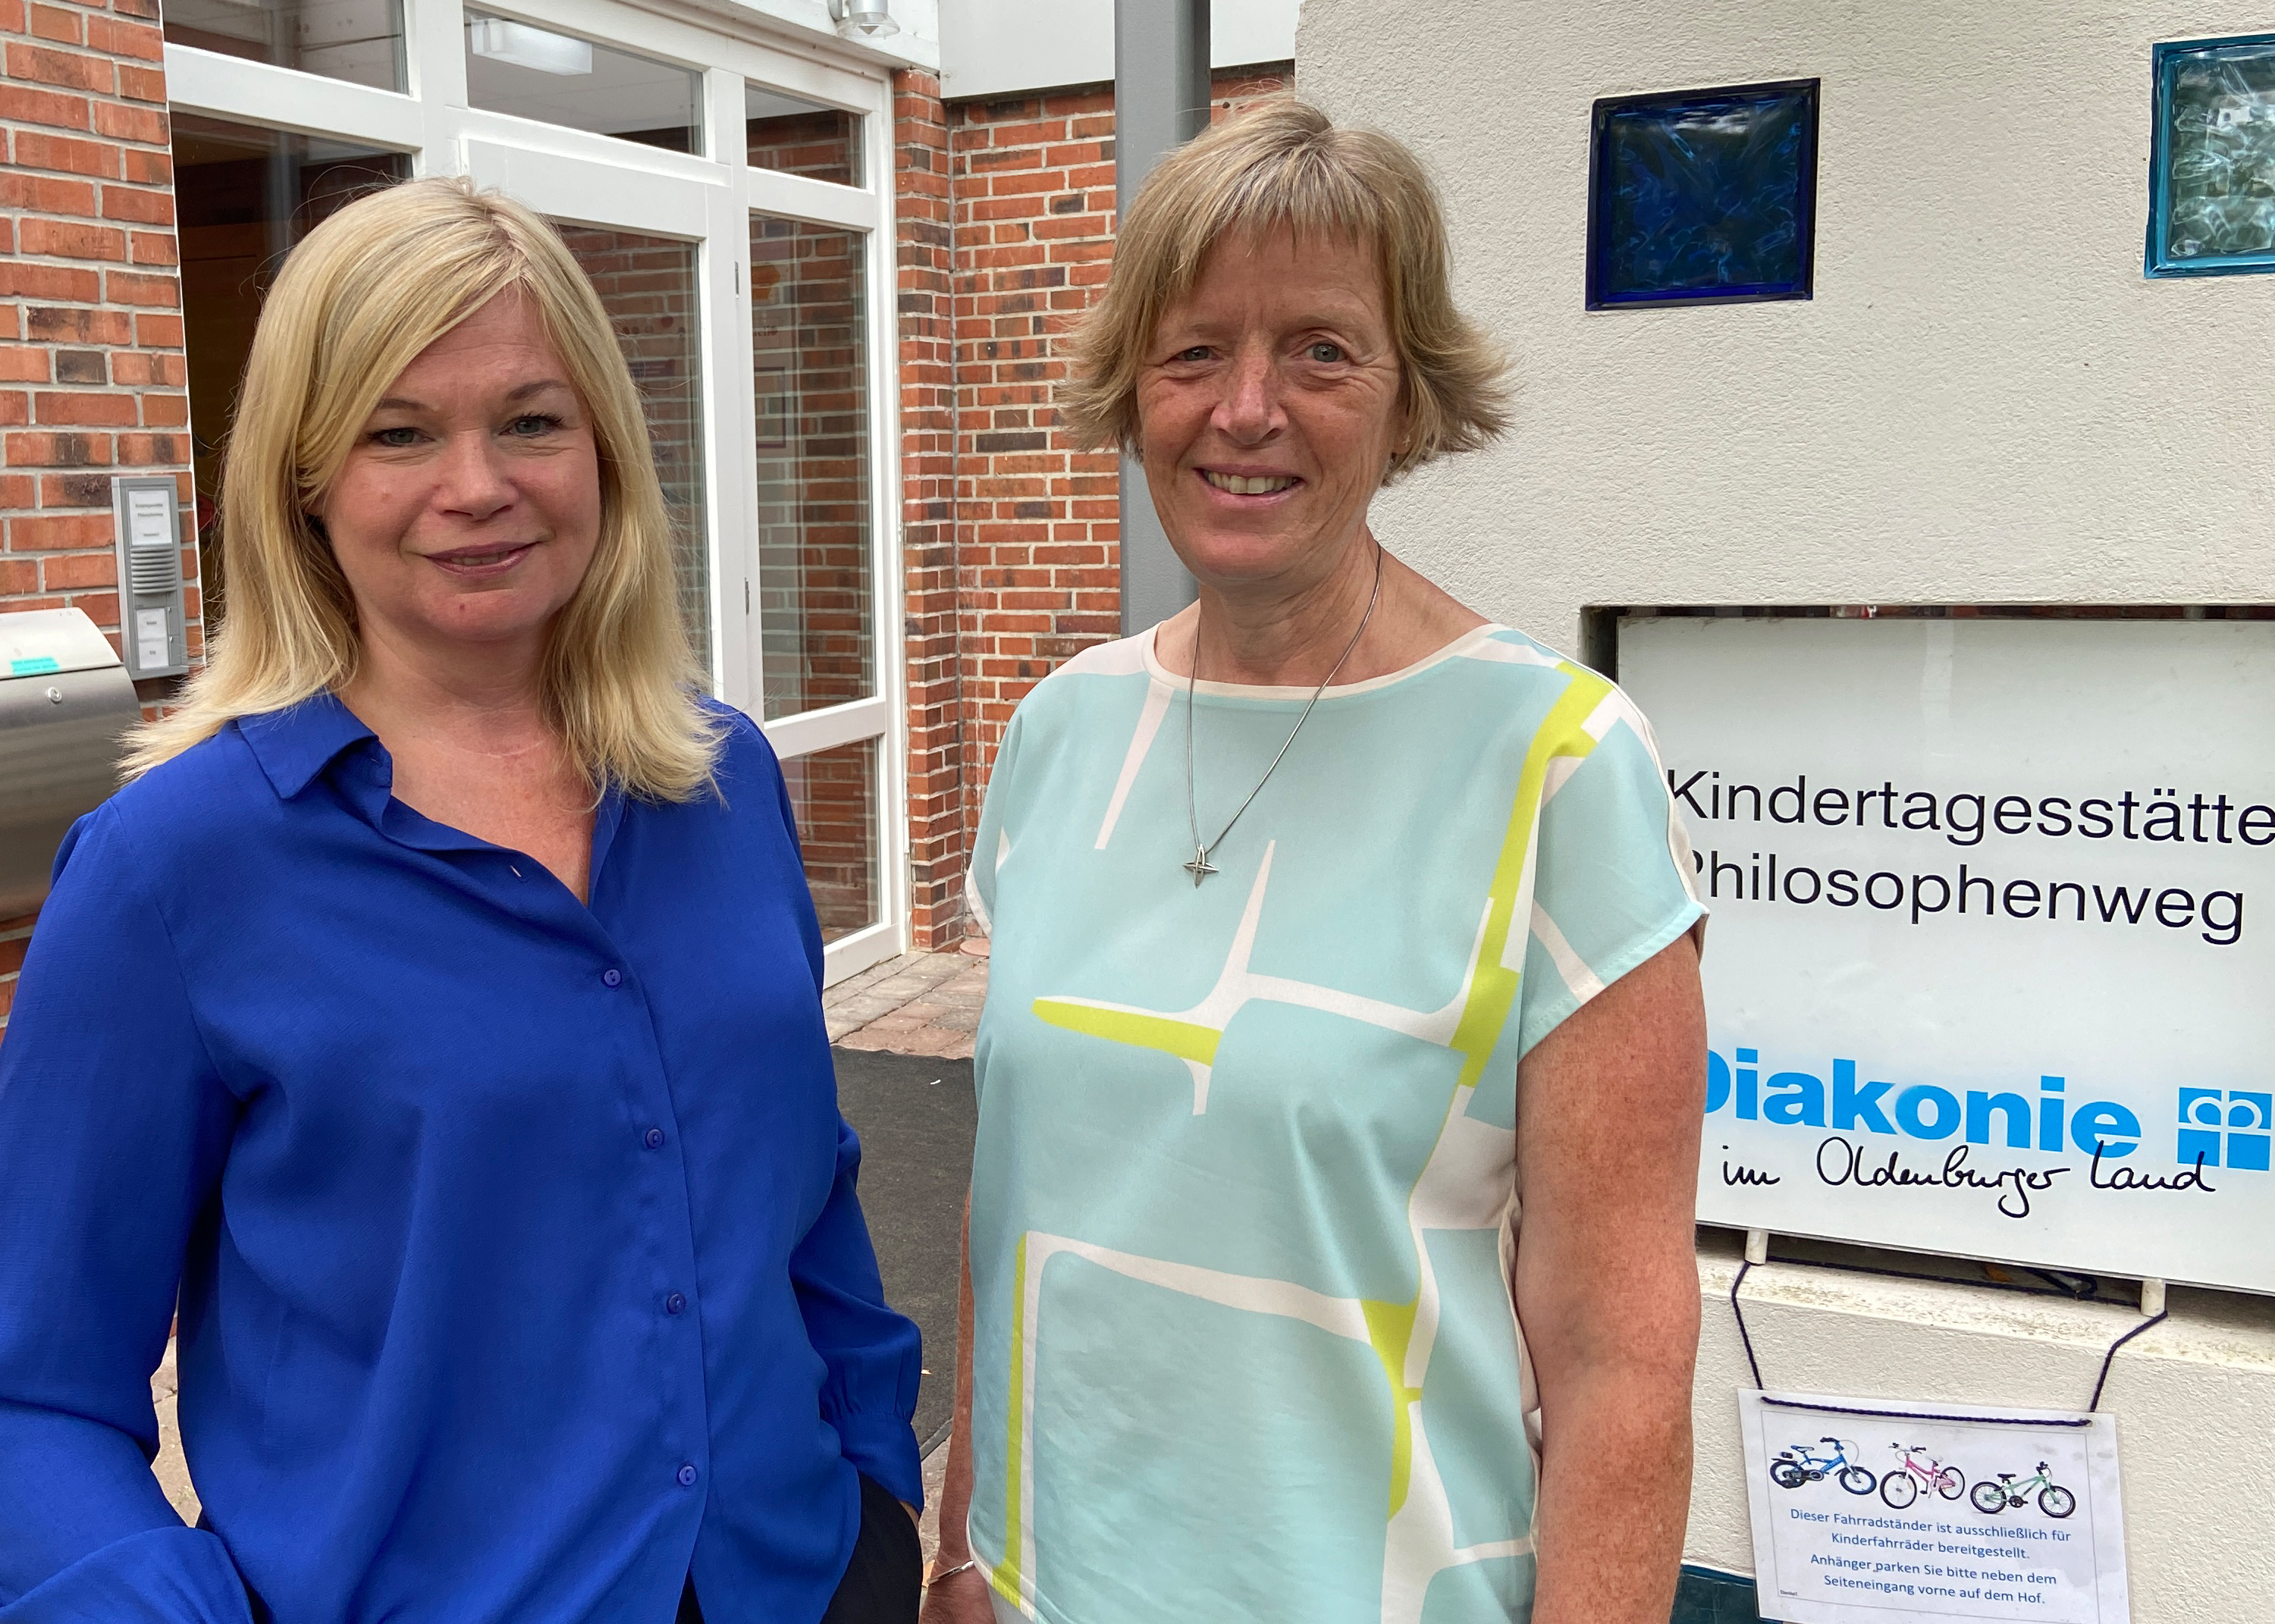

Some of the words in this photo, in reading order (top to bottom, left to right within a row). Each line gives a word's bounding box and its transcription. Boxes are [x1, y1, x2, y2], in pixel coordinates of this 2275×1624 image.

[1668, 769, 2275, 846] Kindertagesstätte
[1692, 849, 2242, 945] hilosophenweg
[1722, 1145, 1781, 1186] im
[1816, 1136, 2070, 1218] Oldenburger
[2091, 1140, 2216, 1193] Land
[1790, 1509, 1830, 1522] Dieser
[1834, 1513, 1933, 1532] Fahrradständer
[1937, 1522, 1952, 1533] ist
[1956, 1526, 2048, 1540] ausschließlich
[2052, 1529, 2071, 1541] für
[1831, 1532, 1935, 1552] Kinderfahrräder
[1938, 1541, 2030, 1560] bereitgestellt.
[1810, 1553, 1872, 1571] Anhänger
[1875, 1561, 1920, 1574] parken
[1924, 1565, 1943, 1576] Sie
[1947, 1566, 1978, 1579] bitte
[1982, 1569, 2023, 1582] neben
[2027, 1572, 2057, 1585] dem
[1824, 1575, 1915, 1595] Seiteneingang
[1918, 1585, 1956, 1597] vorne
[1960, 1588, 1981, 1599] auf
[1985, 1589, 2013, 1601] dem
[2018, 1592, 2046, 1604] Hof.
